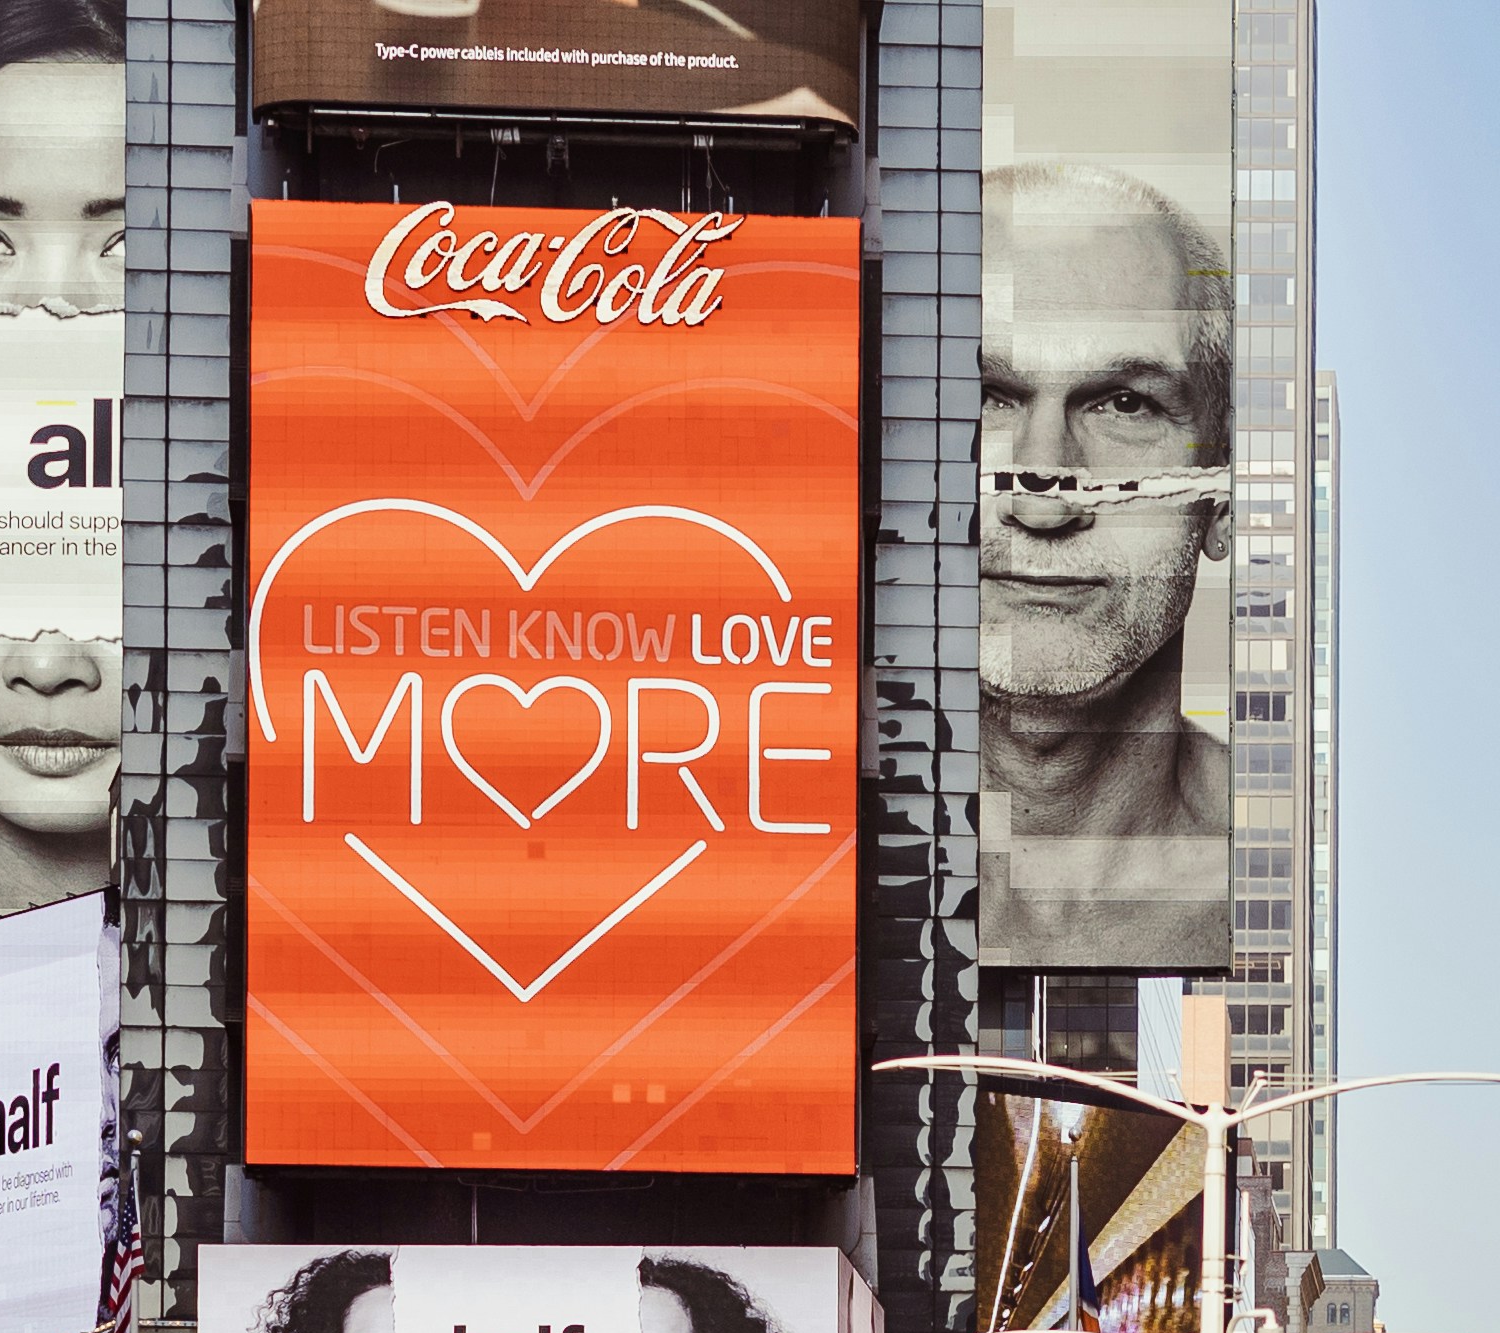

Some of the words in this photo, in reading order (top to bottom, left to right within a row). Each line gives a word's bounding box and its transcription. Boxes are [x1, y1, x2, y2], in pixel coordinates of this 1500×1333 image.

[375, 42, 419, 61] Type-C
[420, 46, 460, 61] power
[506, 47, 559, 63] included
[561, 48, 589, 64] with
[591, 50, 647, 67] purchase
[649, 52, 663, 66] of
[664, 52, 686, 67] the
[687, 53, 739, 69] product.
[69, 515, 124, 533] supp
[62, 537, 78, 555] in
[83, 537, 117, 556] the
[302, 605, 493, 658] LISTEN
[508, 609, 676, 663] KNOW
[692, 614, 833, 668] LOVE
[2, 1175, 12, 1191] be
[14, 1164, 54, 1190] diagnosed
[56, 1162, 73, 1179] with
[15, 1198, 28, 1211] our
